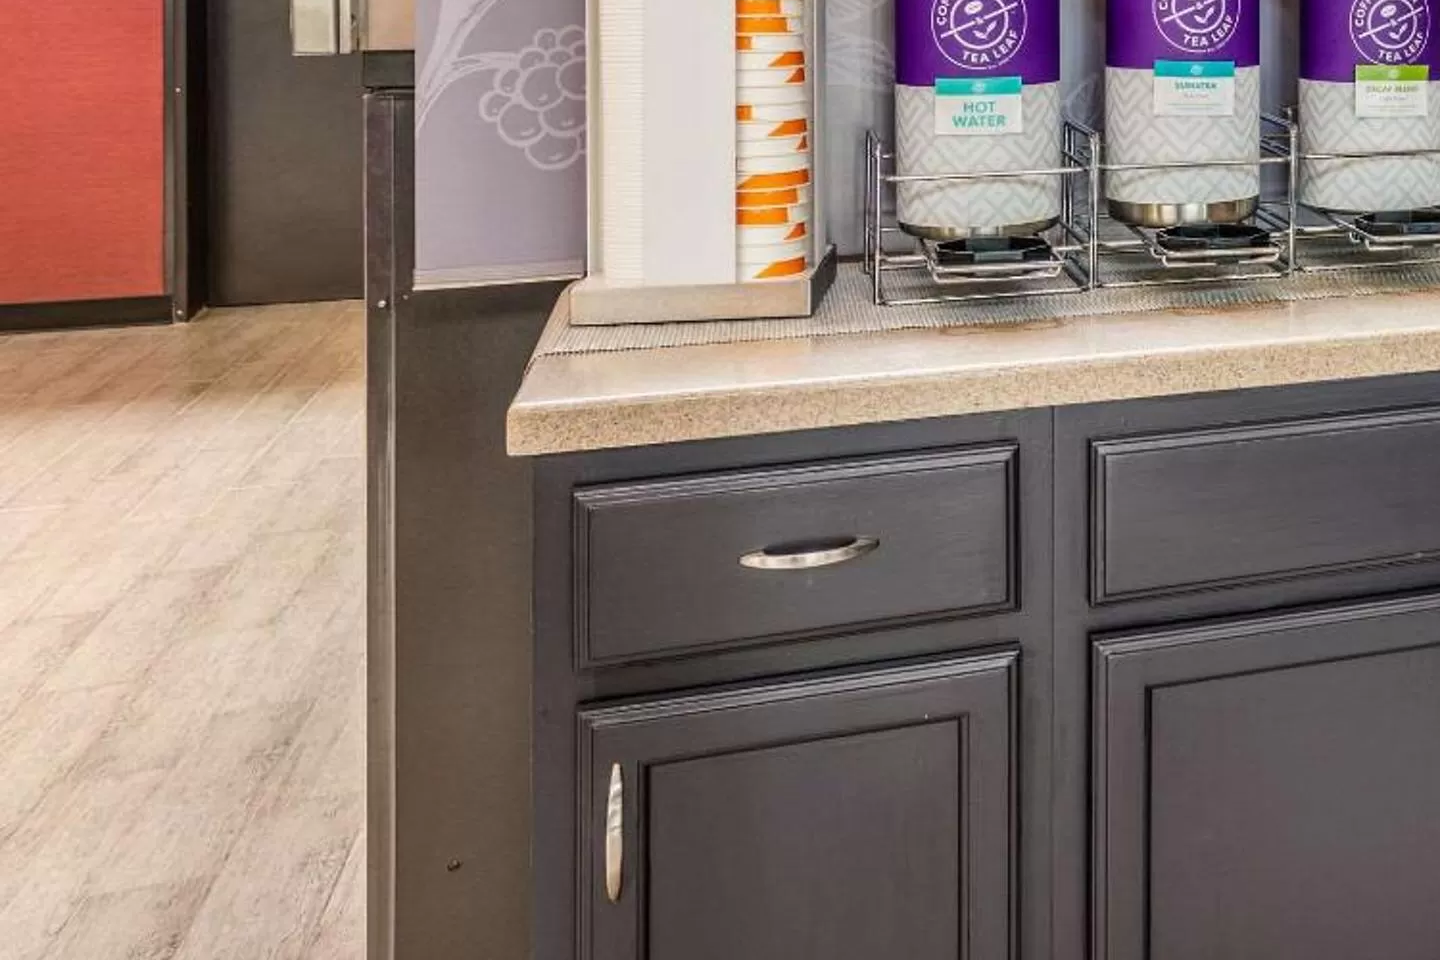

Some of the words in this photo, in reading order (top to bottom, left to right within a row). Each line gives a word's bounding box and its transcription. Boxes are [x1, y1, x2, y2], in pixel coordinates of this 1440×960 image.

[961, 50, 990, 64] TEA
[993, 29, 1019, 60] LEAF
[1183, 33, 1209, 48] TEA
[1211, 14, 1235, 42] LEAF
[1377, 49, 1402, 62] TEA
[1404, 31, 1425, 58] LEAF
[952, 115, 1008, 129] WATER
[962, 101, 996, 114] HOT
